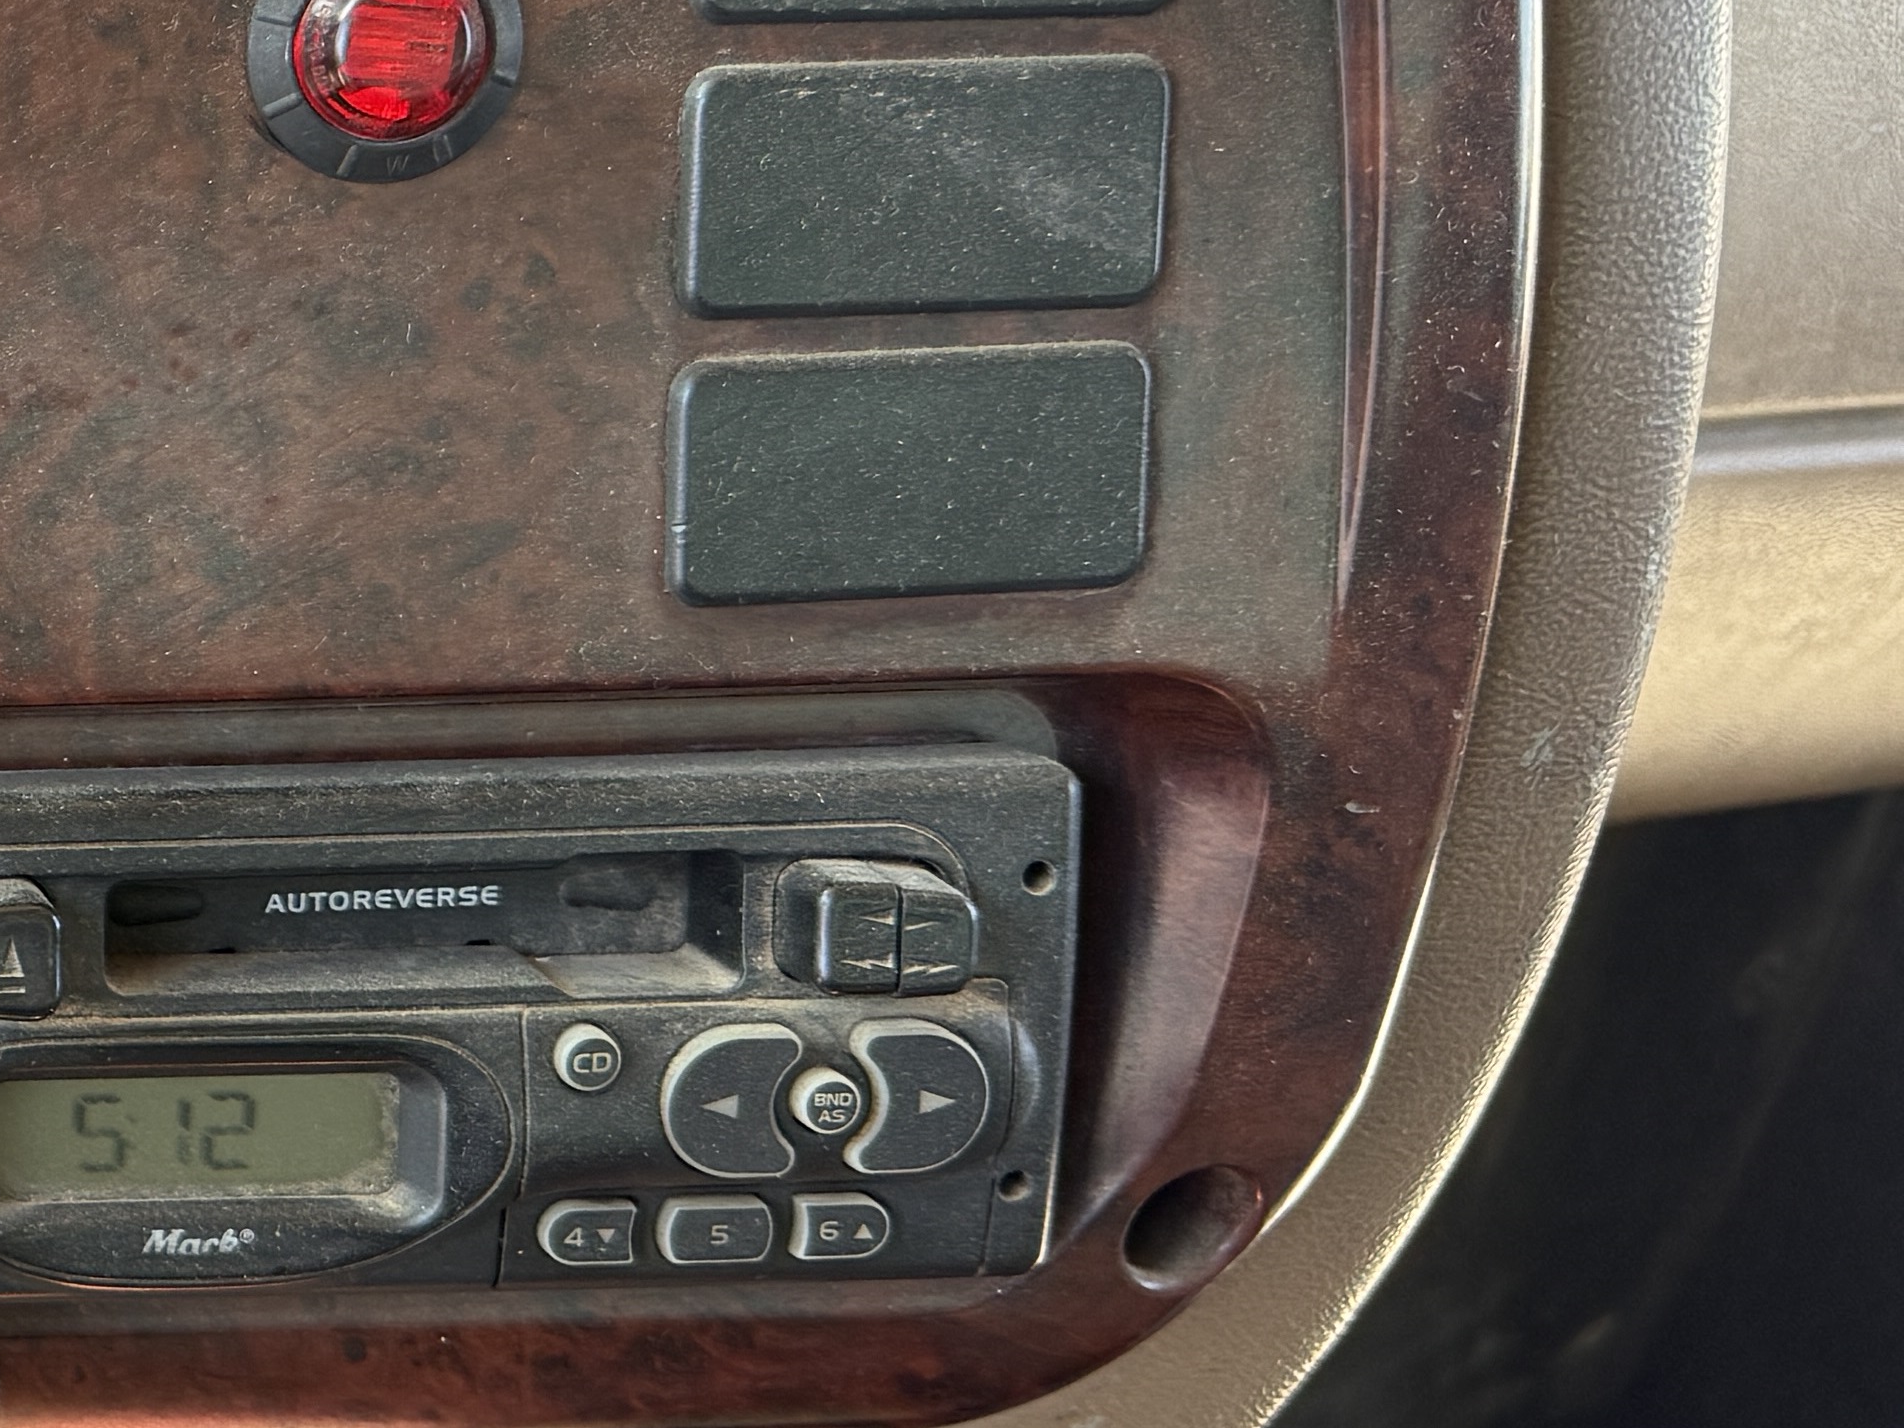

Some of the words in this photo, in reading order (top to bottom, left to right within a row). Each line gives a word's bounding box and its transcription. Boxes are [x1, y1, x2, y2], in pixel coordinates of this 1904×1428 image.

[265, 885, 500, 914] AUTOREVERSE
[573, 1052, 612, 1073] CD
[814, 1092, 853, 1107] BND
[818, 1109, 846, 1123] AS
[563, 1226, 584, 1247] 4
[710, 1225, 730, 1245] 5
[819, 1220, 839, 1241] 6
